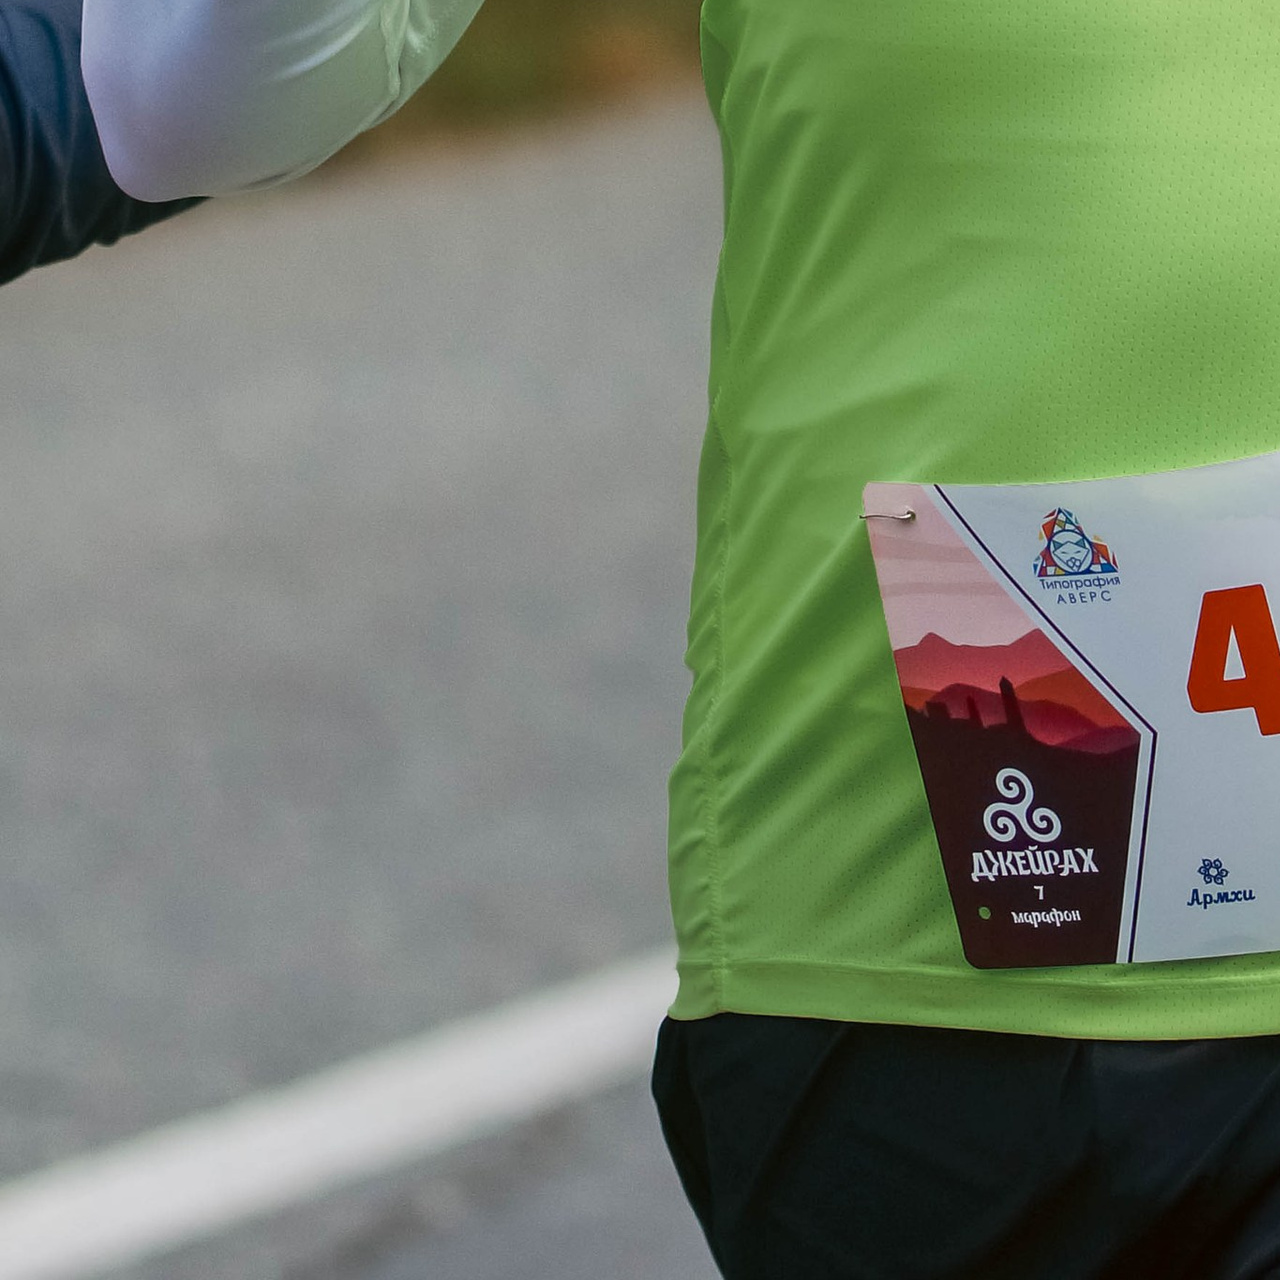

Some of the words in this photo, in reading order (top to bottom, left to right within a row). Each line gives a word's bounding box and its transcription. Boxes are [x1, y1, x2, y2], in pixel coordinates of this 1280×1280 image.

[1040, 576, 1120, 590] Типография
[1057, 590, 1111, 604] АВЕРС
[971, 845, 1099, 882] ДЖЕЙРАХ
[1187, 888, 1256, 910] Армхи
[1011, 908, 1081, 928] марафон
